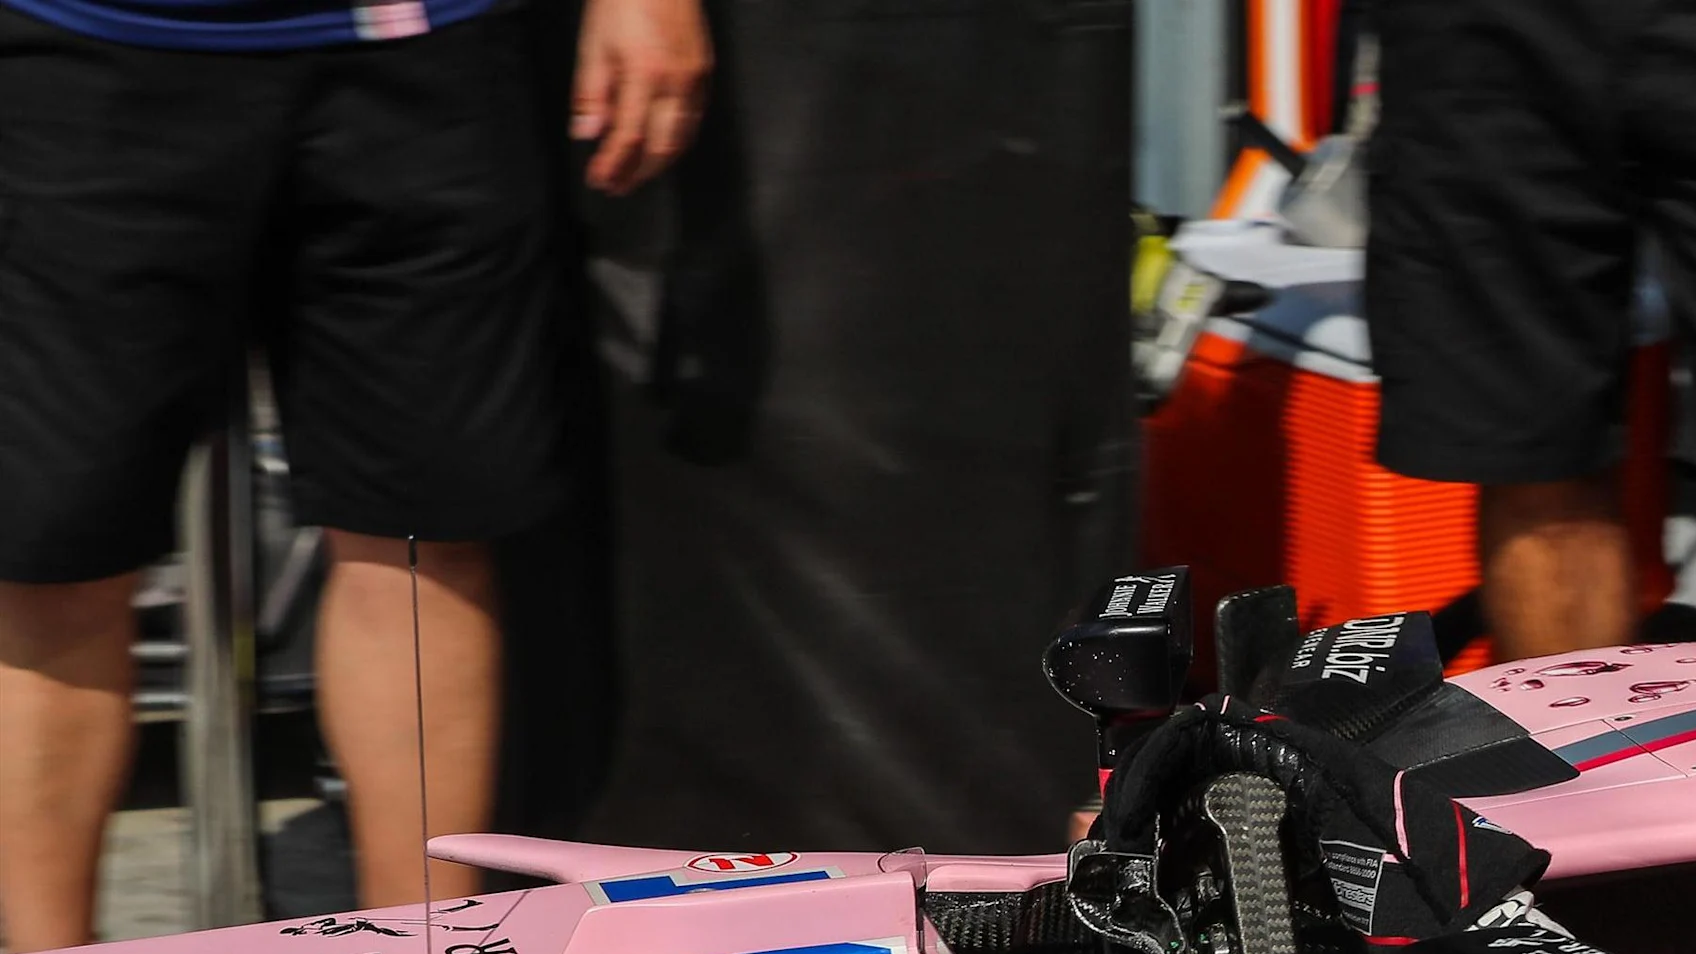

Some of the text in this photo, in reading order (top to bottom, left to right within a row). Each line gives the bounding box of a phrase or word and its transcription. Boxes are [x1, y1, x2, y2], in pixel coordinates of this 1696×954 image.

[1099, 584, 1137, 617] JOHNNIE
[1136, 583, 1174, 614] WALKER
[1321, 611, 1406, 684] DNR.biz
